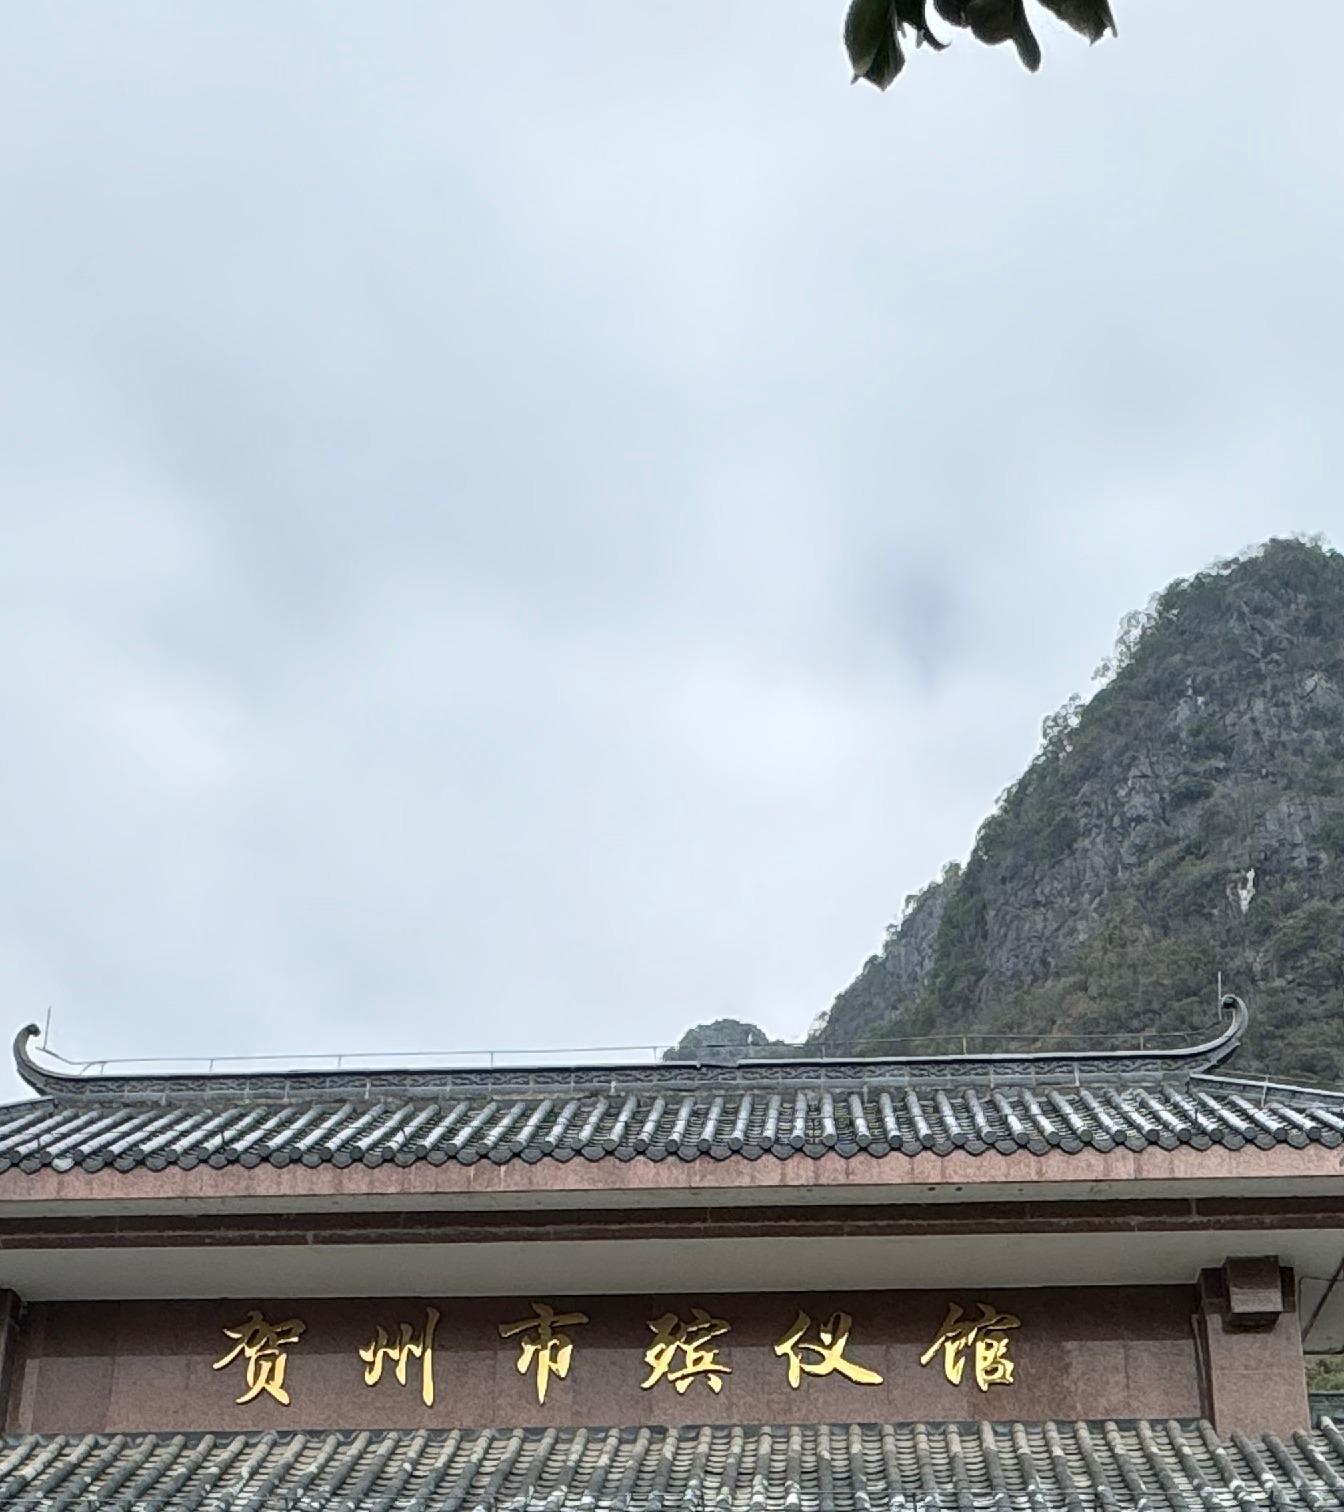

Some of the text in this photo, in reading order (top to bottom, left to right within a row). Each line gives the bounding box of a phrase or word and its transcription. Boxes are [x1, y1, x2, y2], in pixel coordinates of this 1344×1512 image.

[213, 1301, 1021, 1406] 贺州市殡仪馆
